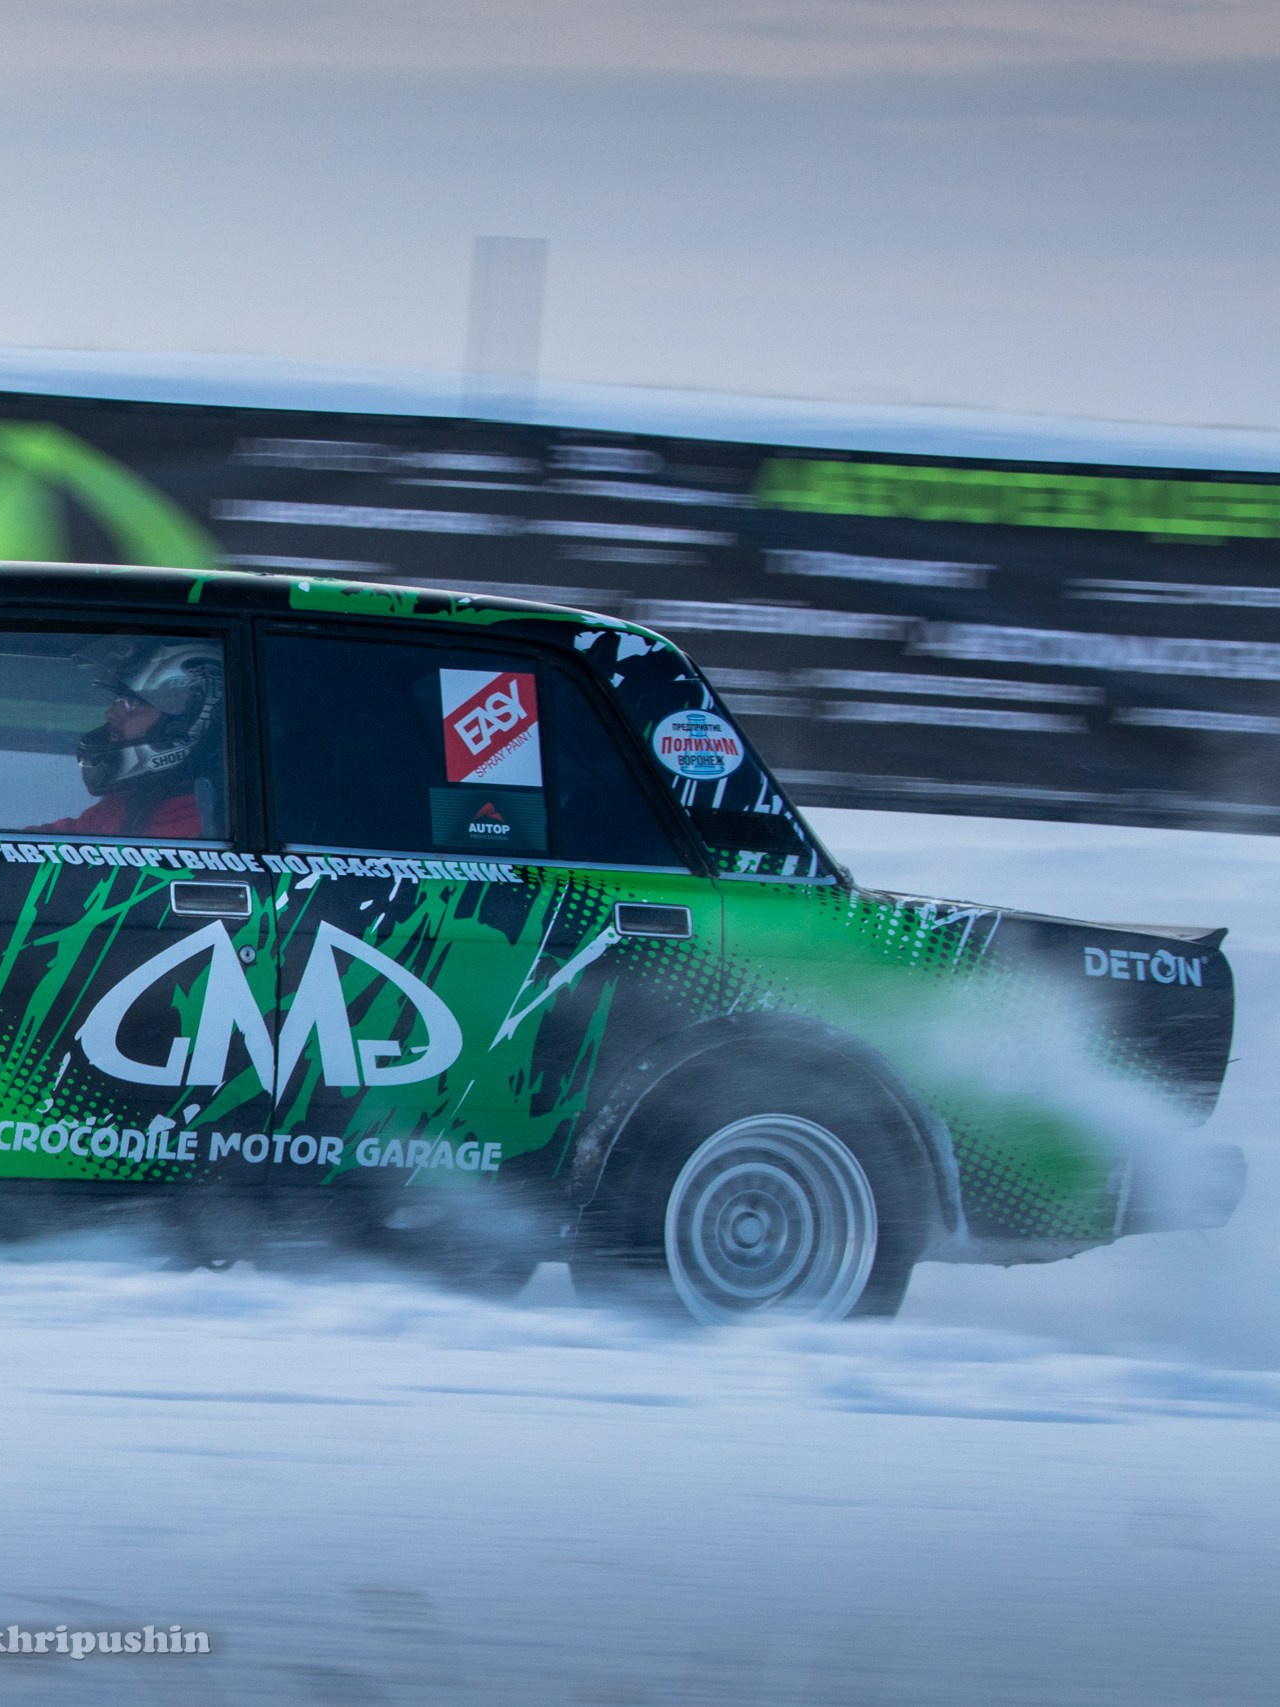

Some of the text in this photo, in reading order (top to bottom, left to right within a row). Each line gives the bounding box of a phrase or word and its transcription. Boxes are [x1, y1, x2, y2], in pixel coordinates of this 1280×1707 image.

[453, 679, 528, 756] EASY
[672, 723, 722, 732] ПРЕДПРИЯТИЕ
[475, 730, 532, 778] SPRAY PAINT
[677, 755, 725, 766] ВОРОНЕЖ
[468, 822, 511, 835] AUTOP
[261, 854, 523, 884] ПОДРАЗДЕЛЕНИЕ
[208, 1131, 343, 1166] MOTOR
[355, 1137, 503, 1172] GARAGE
